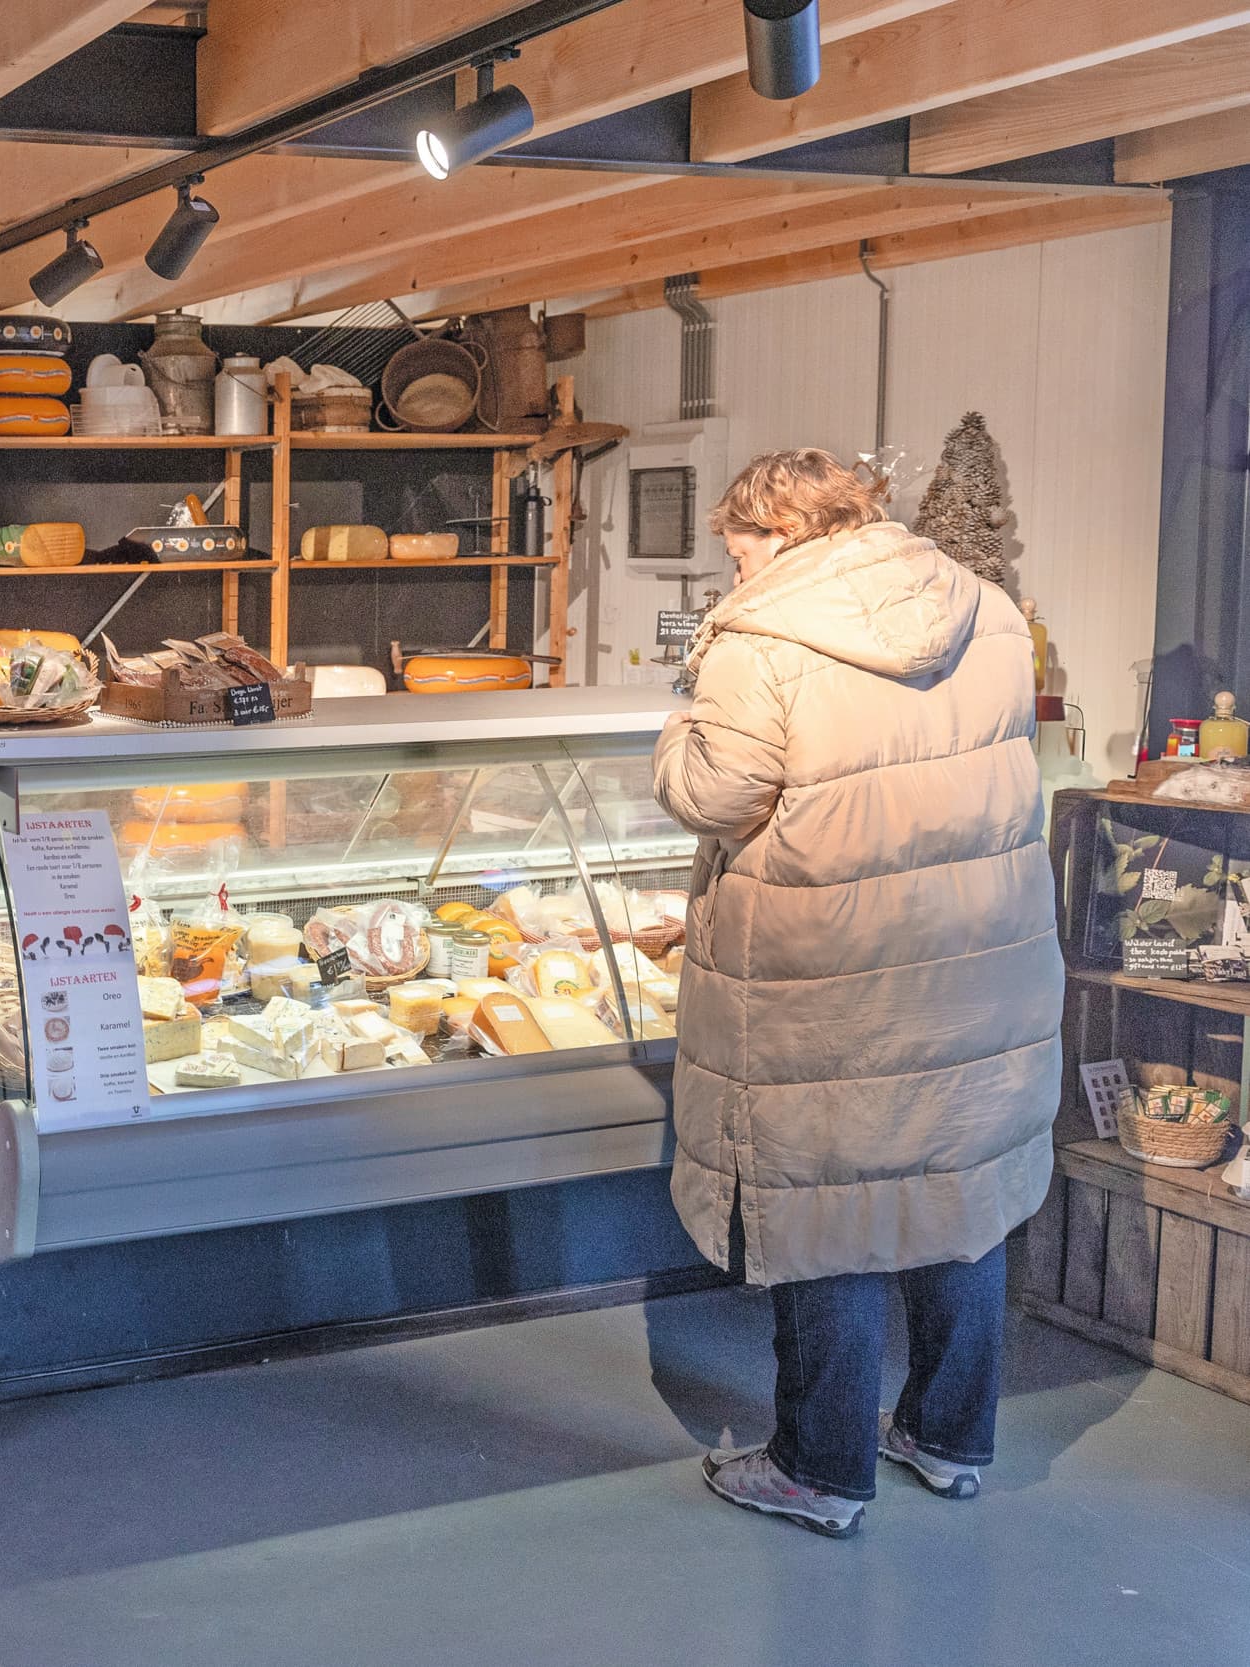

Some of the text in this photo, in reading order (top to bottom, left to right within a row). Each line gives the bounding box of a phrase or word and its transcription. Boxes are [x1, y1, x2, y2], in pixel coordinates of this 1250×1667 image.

[125, 697, 142, 710] 1965
[189, 701, 208, 715] Fa.
[25, 819, 92, 830] IJSTAARTEN
[50, 971, 117, 987] IJSTAARTEN
[102, 992, 121, 1001] Oreo
[100, 1020, 131, 1031] Karamel
